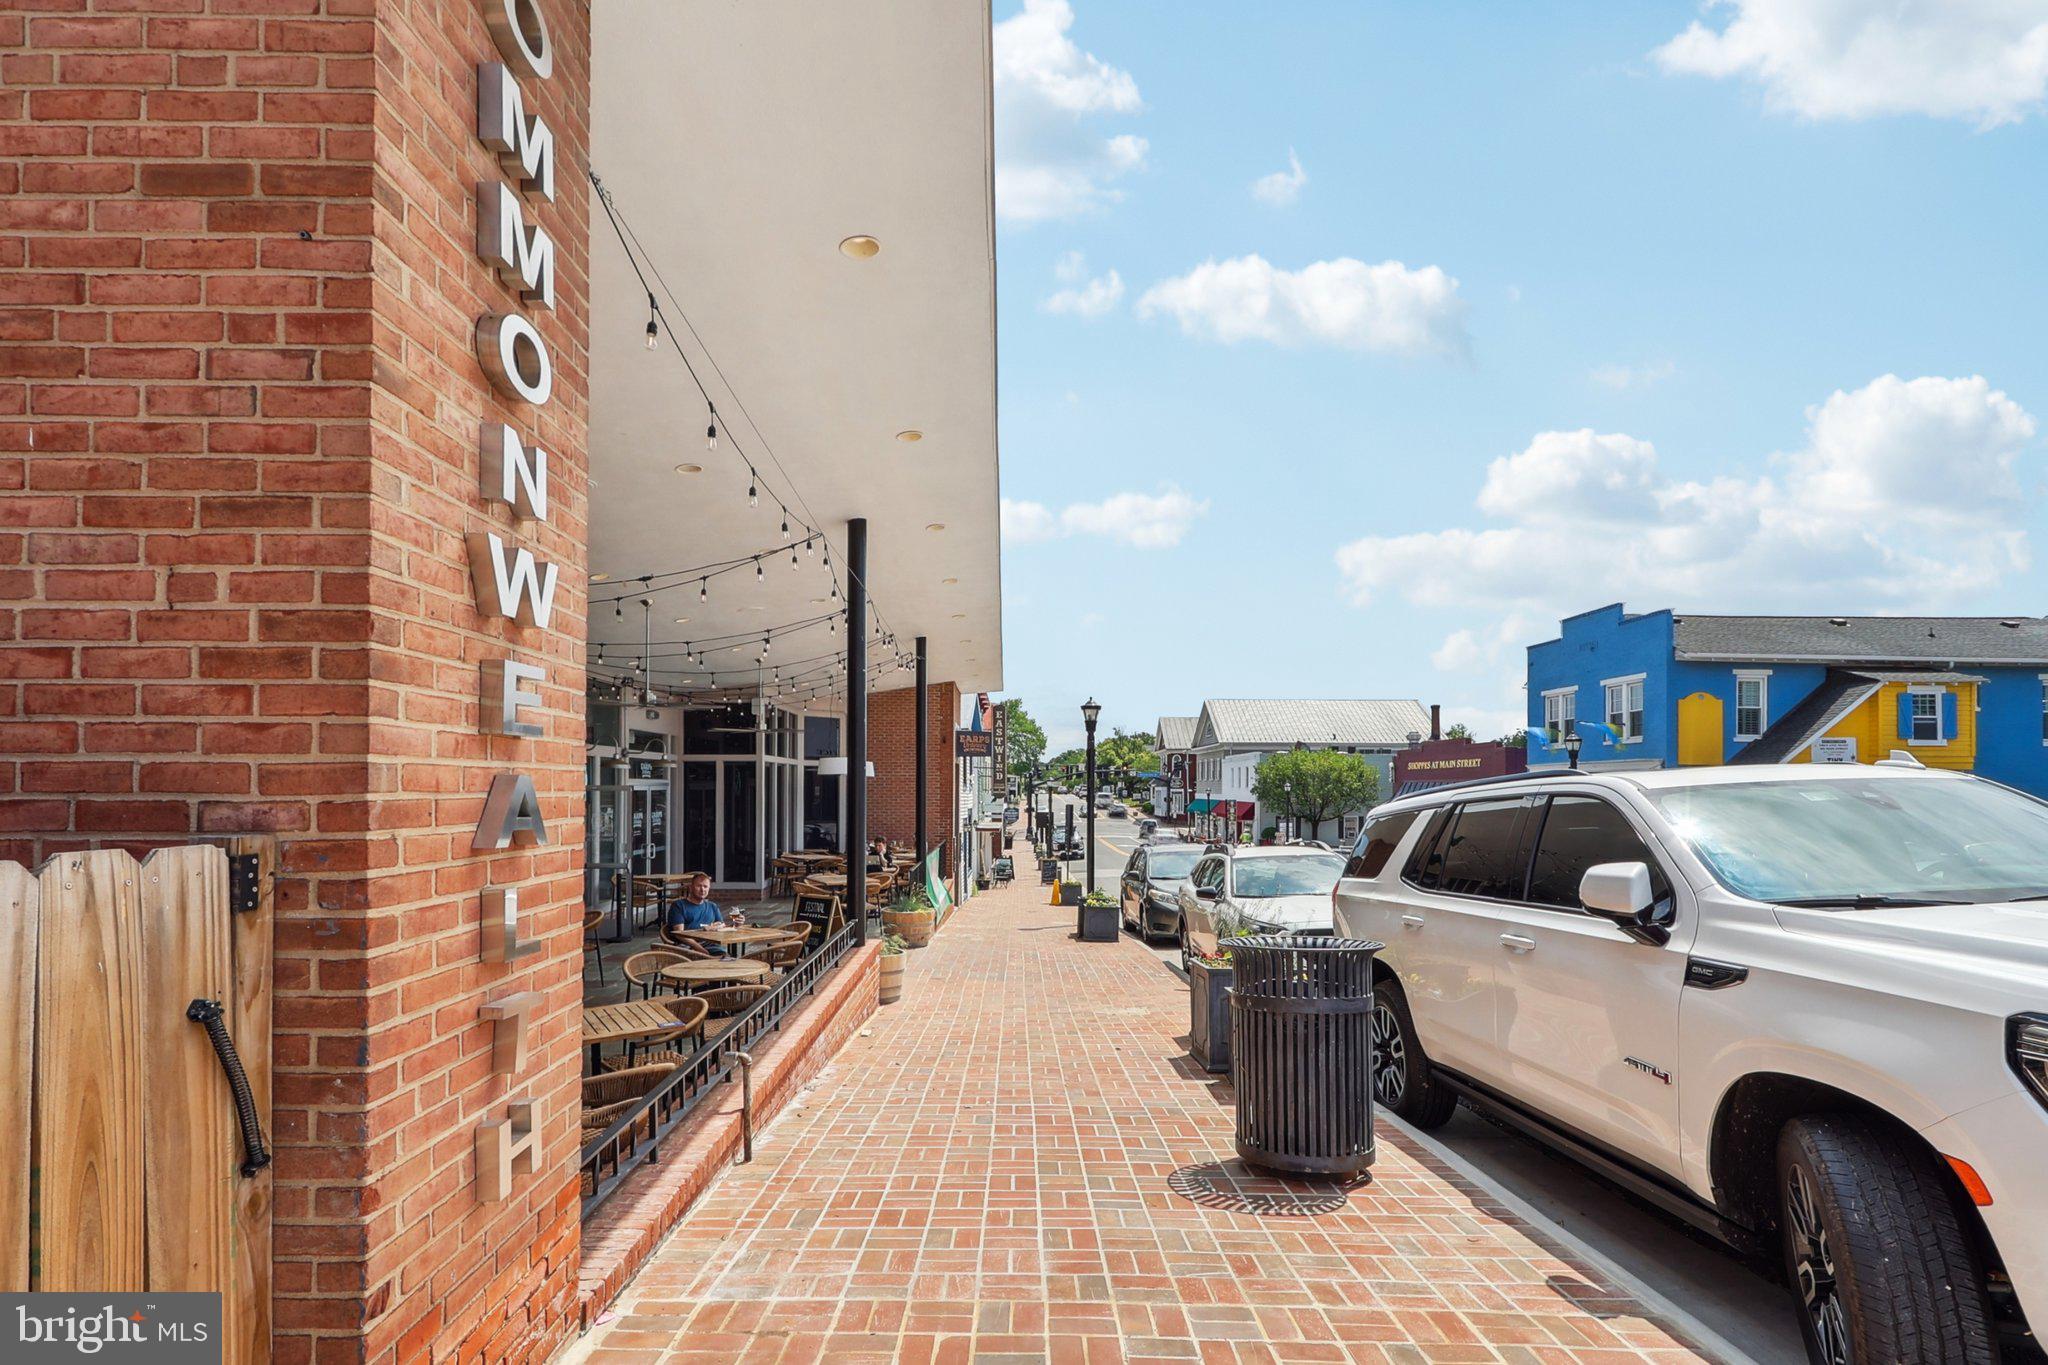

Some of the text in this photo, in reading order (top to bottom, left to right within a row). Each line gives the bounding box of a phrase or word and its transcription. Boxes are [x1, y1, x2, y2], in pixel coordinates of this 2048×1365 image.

[994, 710, 1005, 780] EASTWIND
[1408, 759, 1482, 770] SHOPPES AT MAIN STREET
[1691, 966, 1714, 977] GMC
